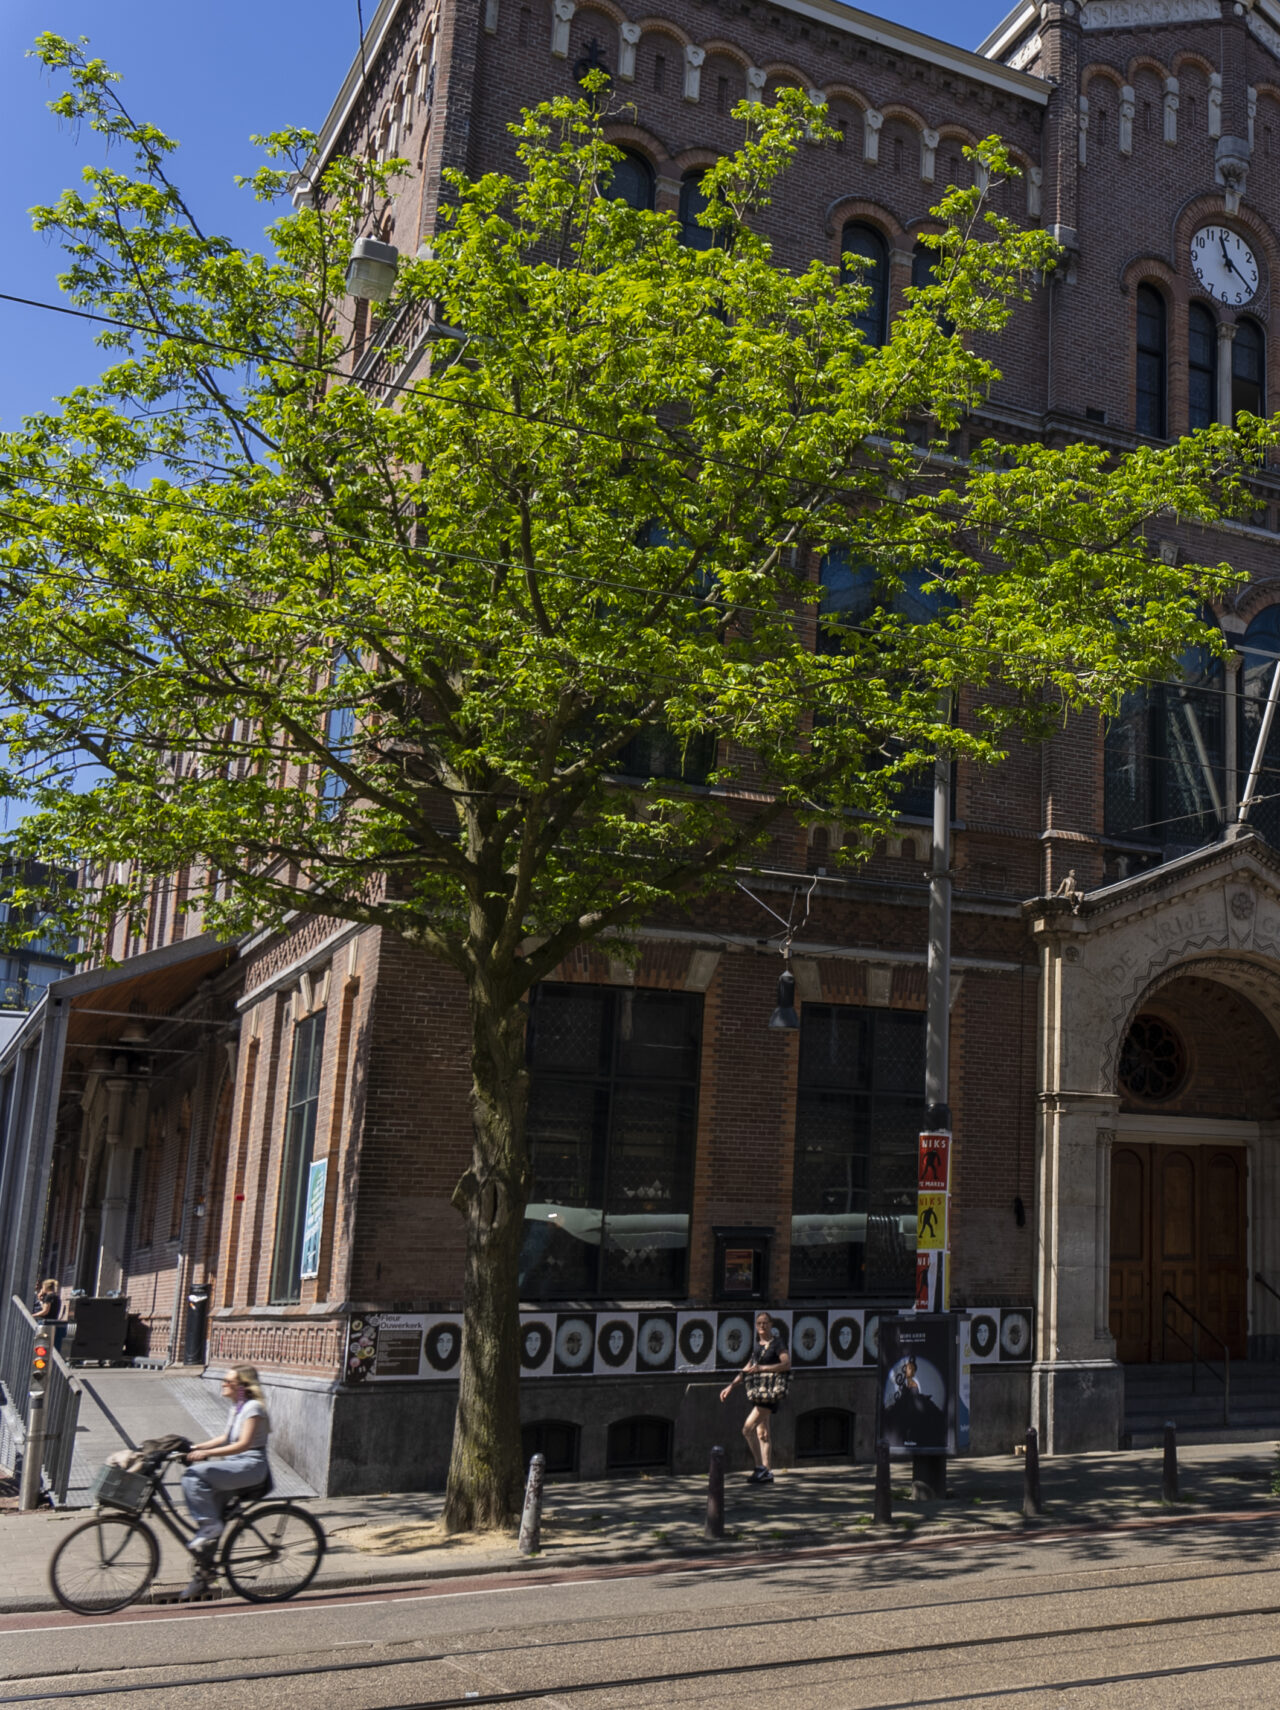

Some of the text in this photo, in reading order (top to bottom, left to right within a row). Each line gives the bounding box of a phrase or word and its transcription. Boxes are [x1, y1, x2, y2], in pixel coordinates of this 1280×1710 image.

[1206, 228, 1215, 242] 11
[1219, 229, 1230, 242] 12
[1196, 235, 1206, 249] 10
[1236, 239, 1241, 250] 1
[1191, 250, 1198, 262] 9
[1245, 251, 1253, 264] 2
[1196, 267, 1204, 280] 8
[1250, 270, 1258, 282] 3
[1207, 282, 1215, 295] 7
[1244, 286, 1252, 297] 4
[1221, 291, 1228, 304] 6
[1234, 292, 1242, 304] 5
[1143, 910, 1213, 945] VRIJE
[921, 1139, 946, 1149] NIKS
[919, 1197, 942, 1206] NIKS
[380, 1313, 401, 1321] Fleur
[380, 1321, 423, 1329] Ouwerkerk
